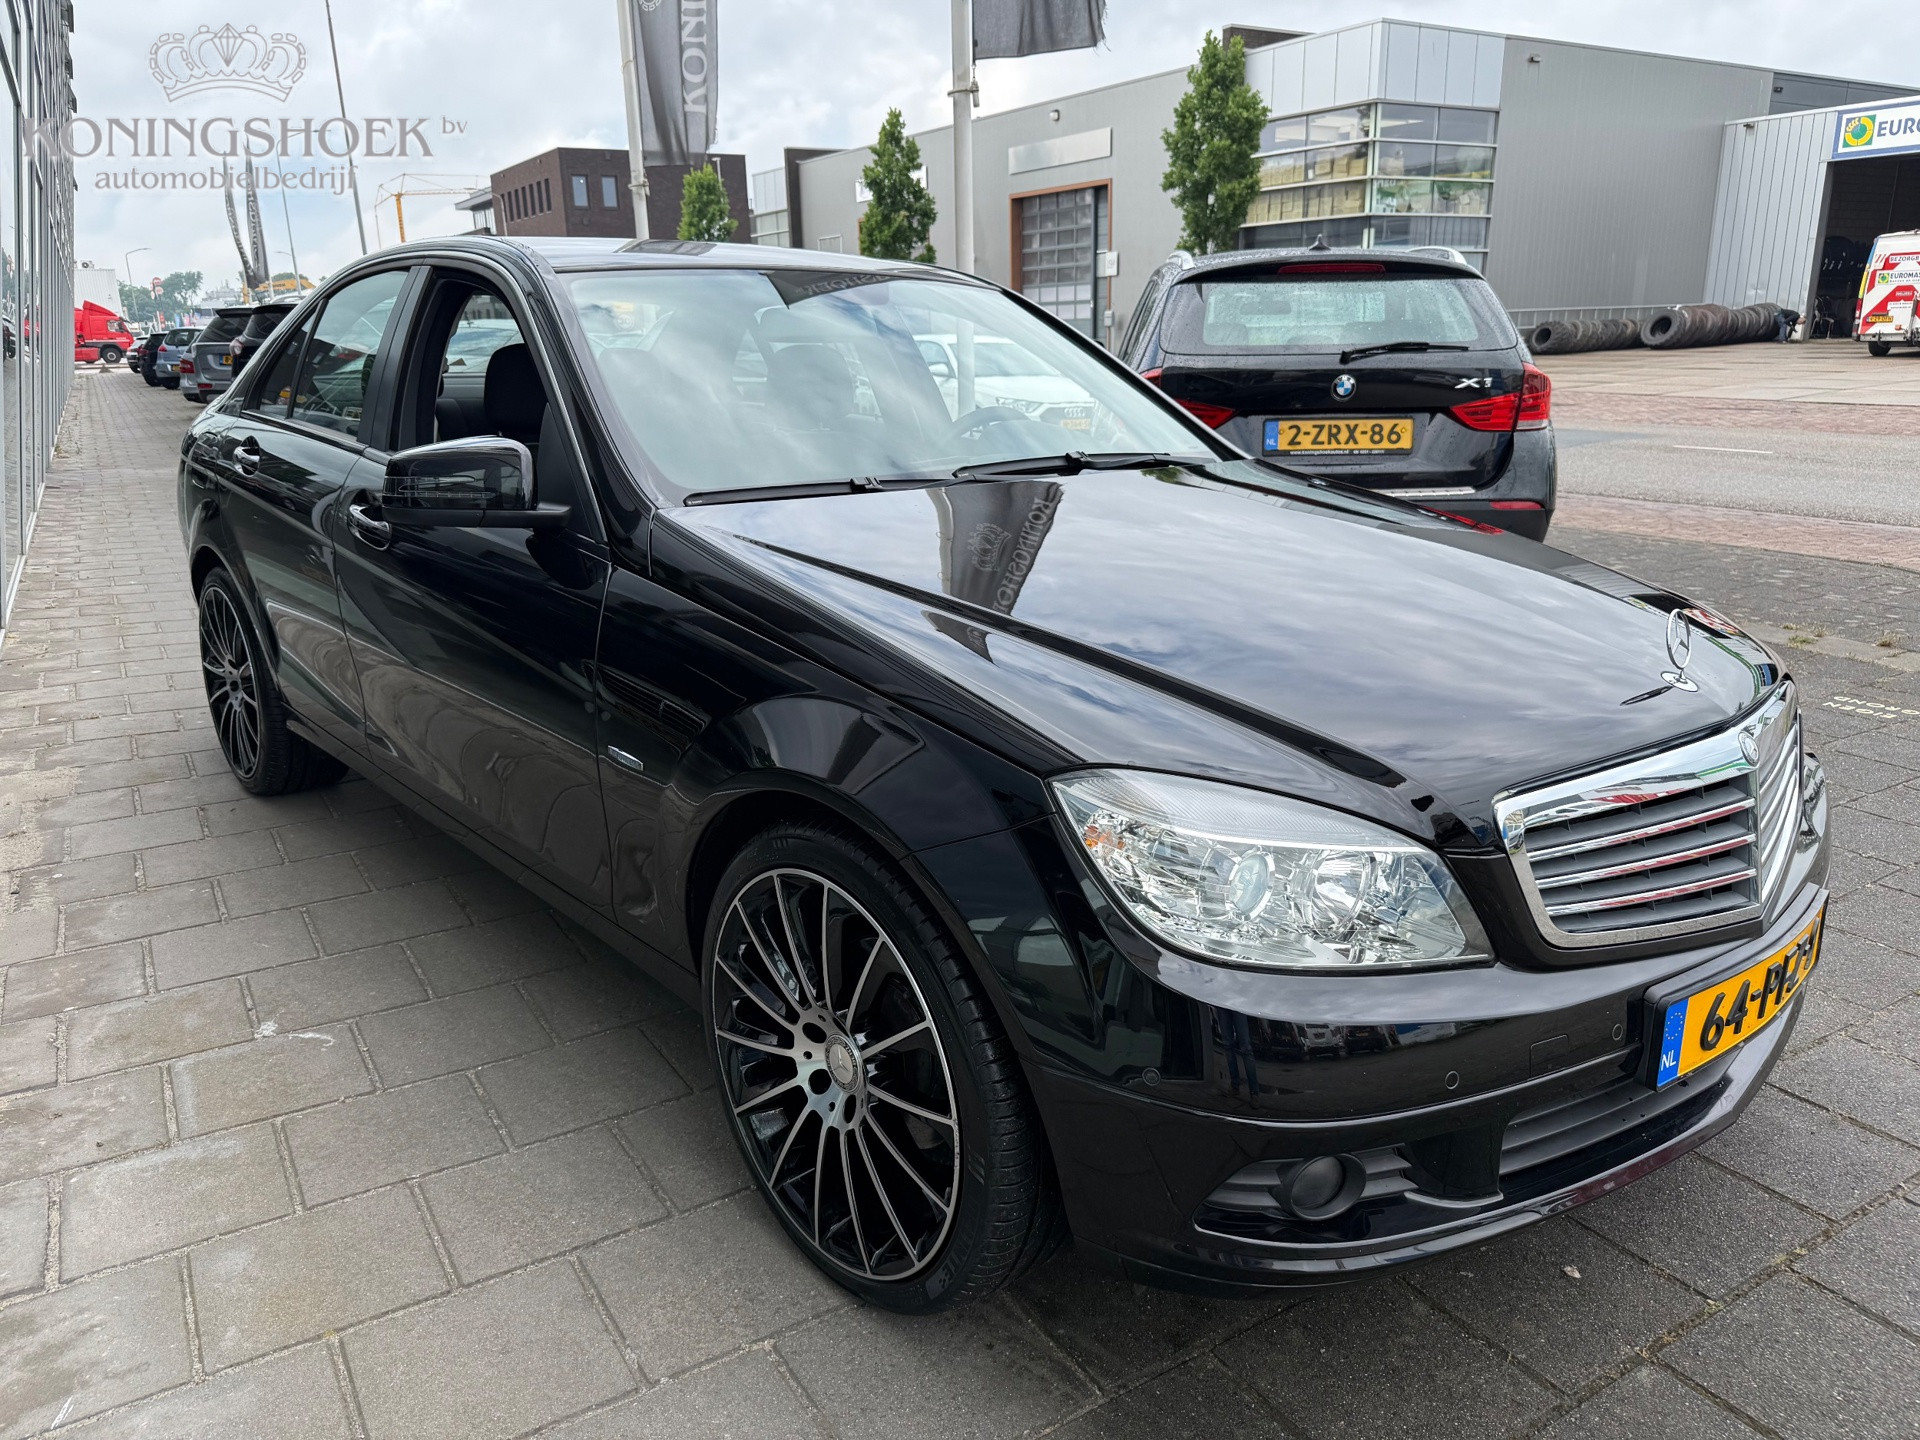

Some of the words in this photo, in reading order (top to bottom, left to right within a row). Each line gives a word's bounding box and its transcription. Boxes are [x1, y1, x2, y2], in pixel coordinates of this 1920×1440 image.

[1877, 117, 1920, 137] EUR
[1454, 377, 1493, 389] X1
[1266, 438, 1276, 446] NL
[1287, 423, 1402, 446] 2-ZRX-86
[1660, 1050, 1677, 1071] NL
